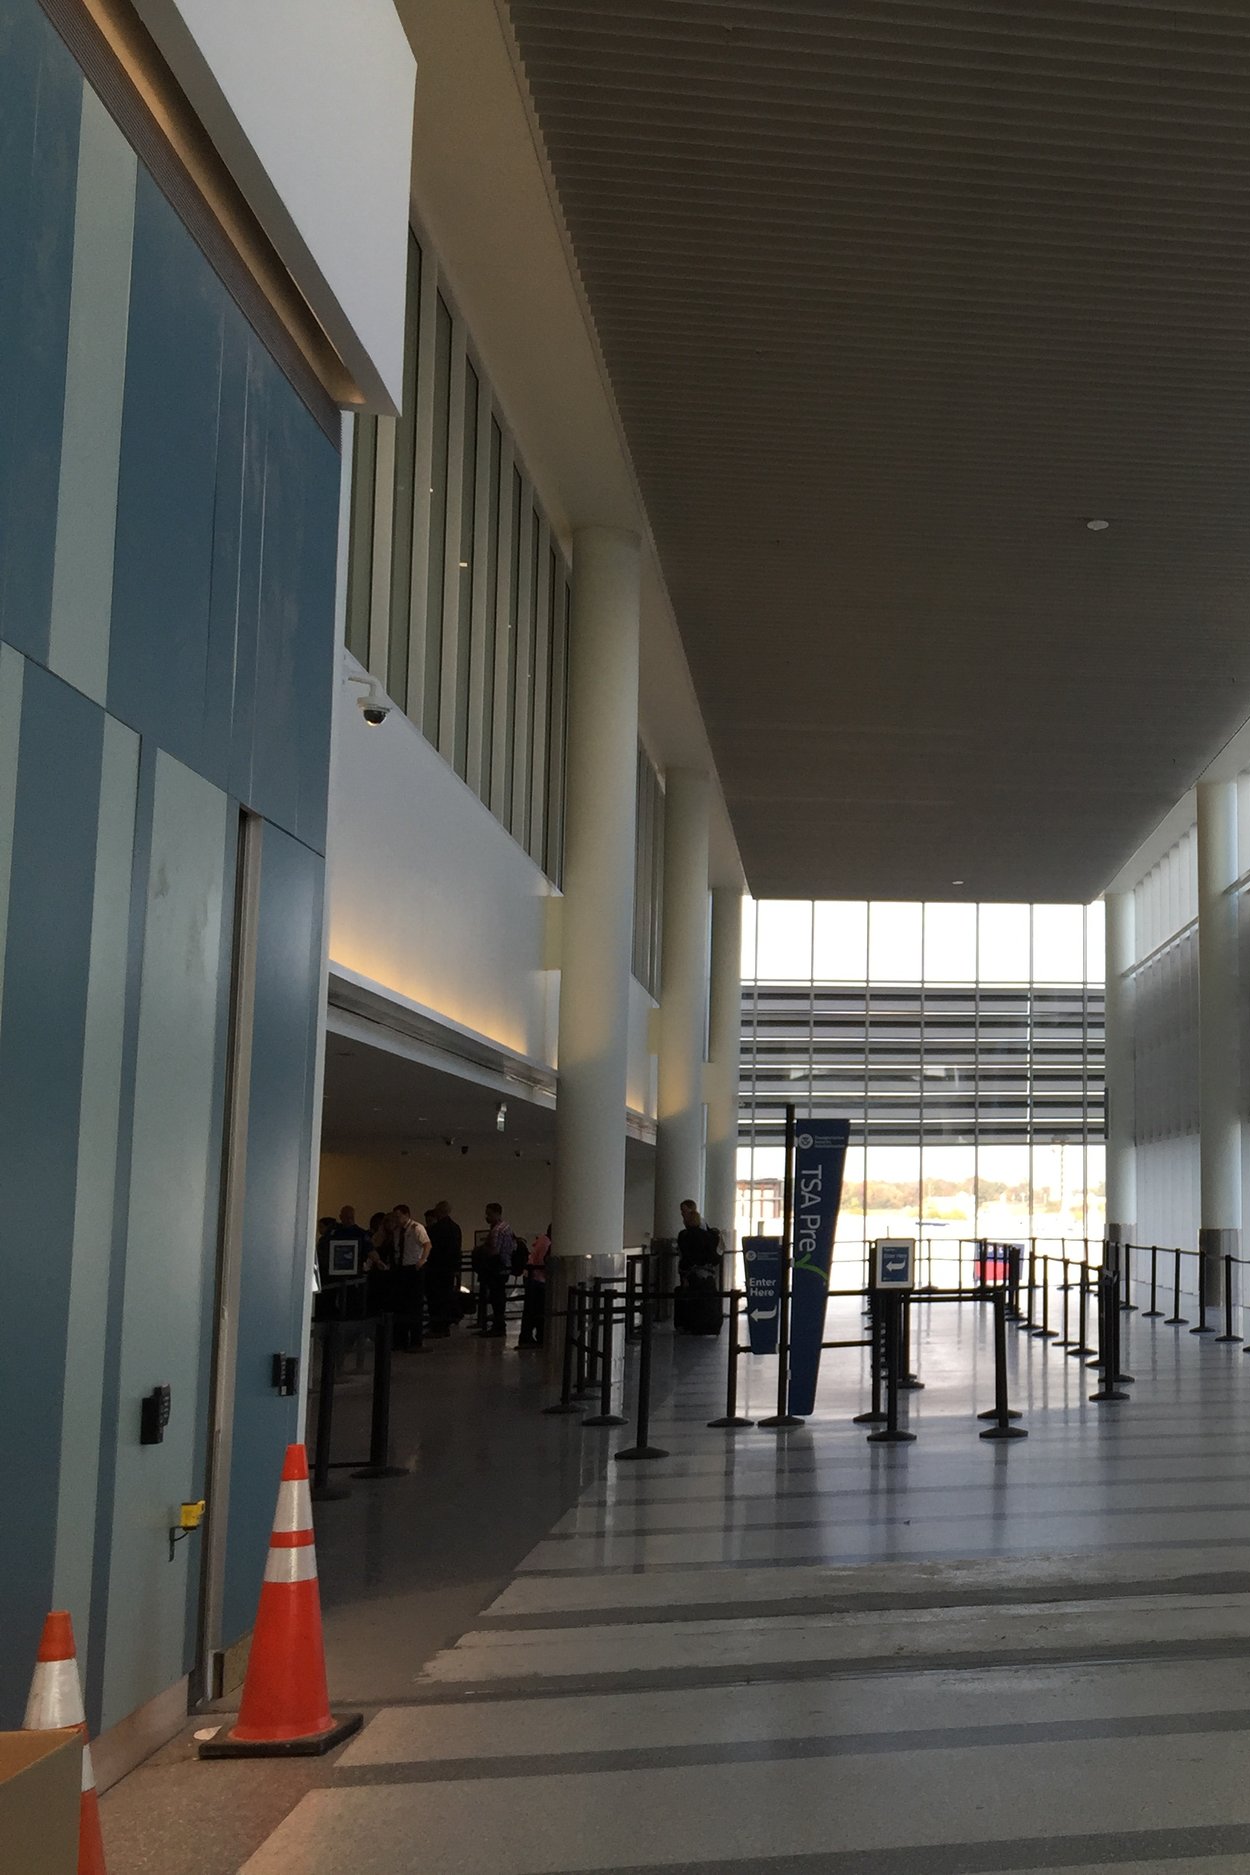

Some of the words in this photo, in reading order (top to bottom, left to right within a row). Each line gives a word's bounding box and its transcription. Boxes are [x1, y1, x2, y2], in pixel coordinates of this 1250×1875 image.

[800, 1164, 822, 1209] TSA
[749, 1277, 777, 1287] Enter
[750, 1287, 775, 1297] Here
